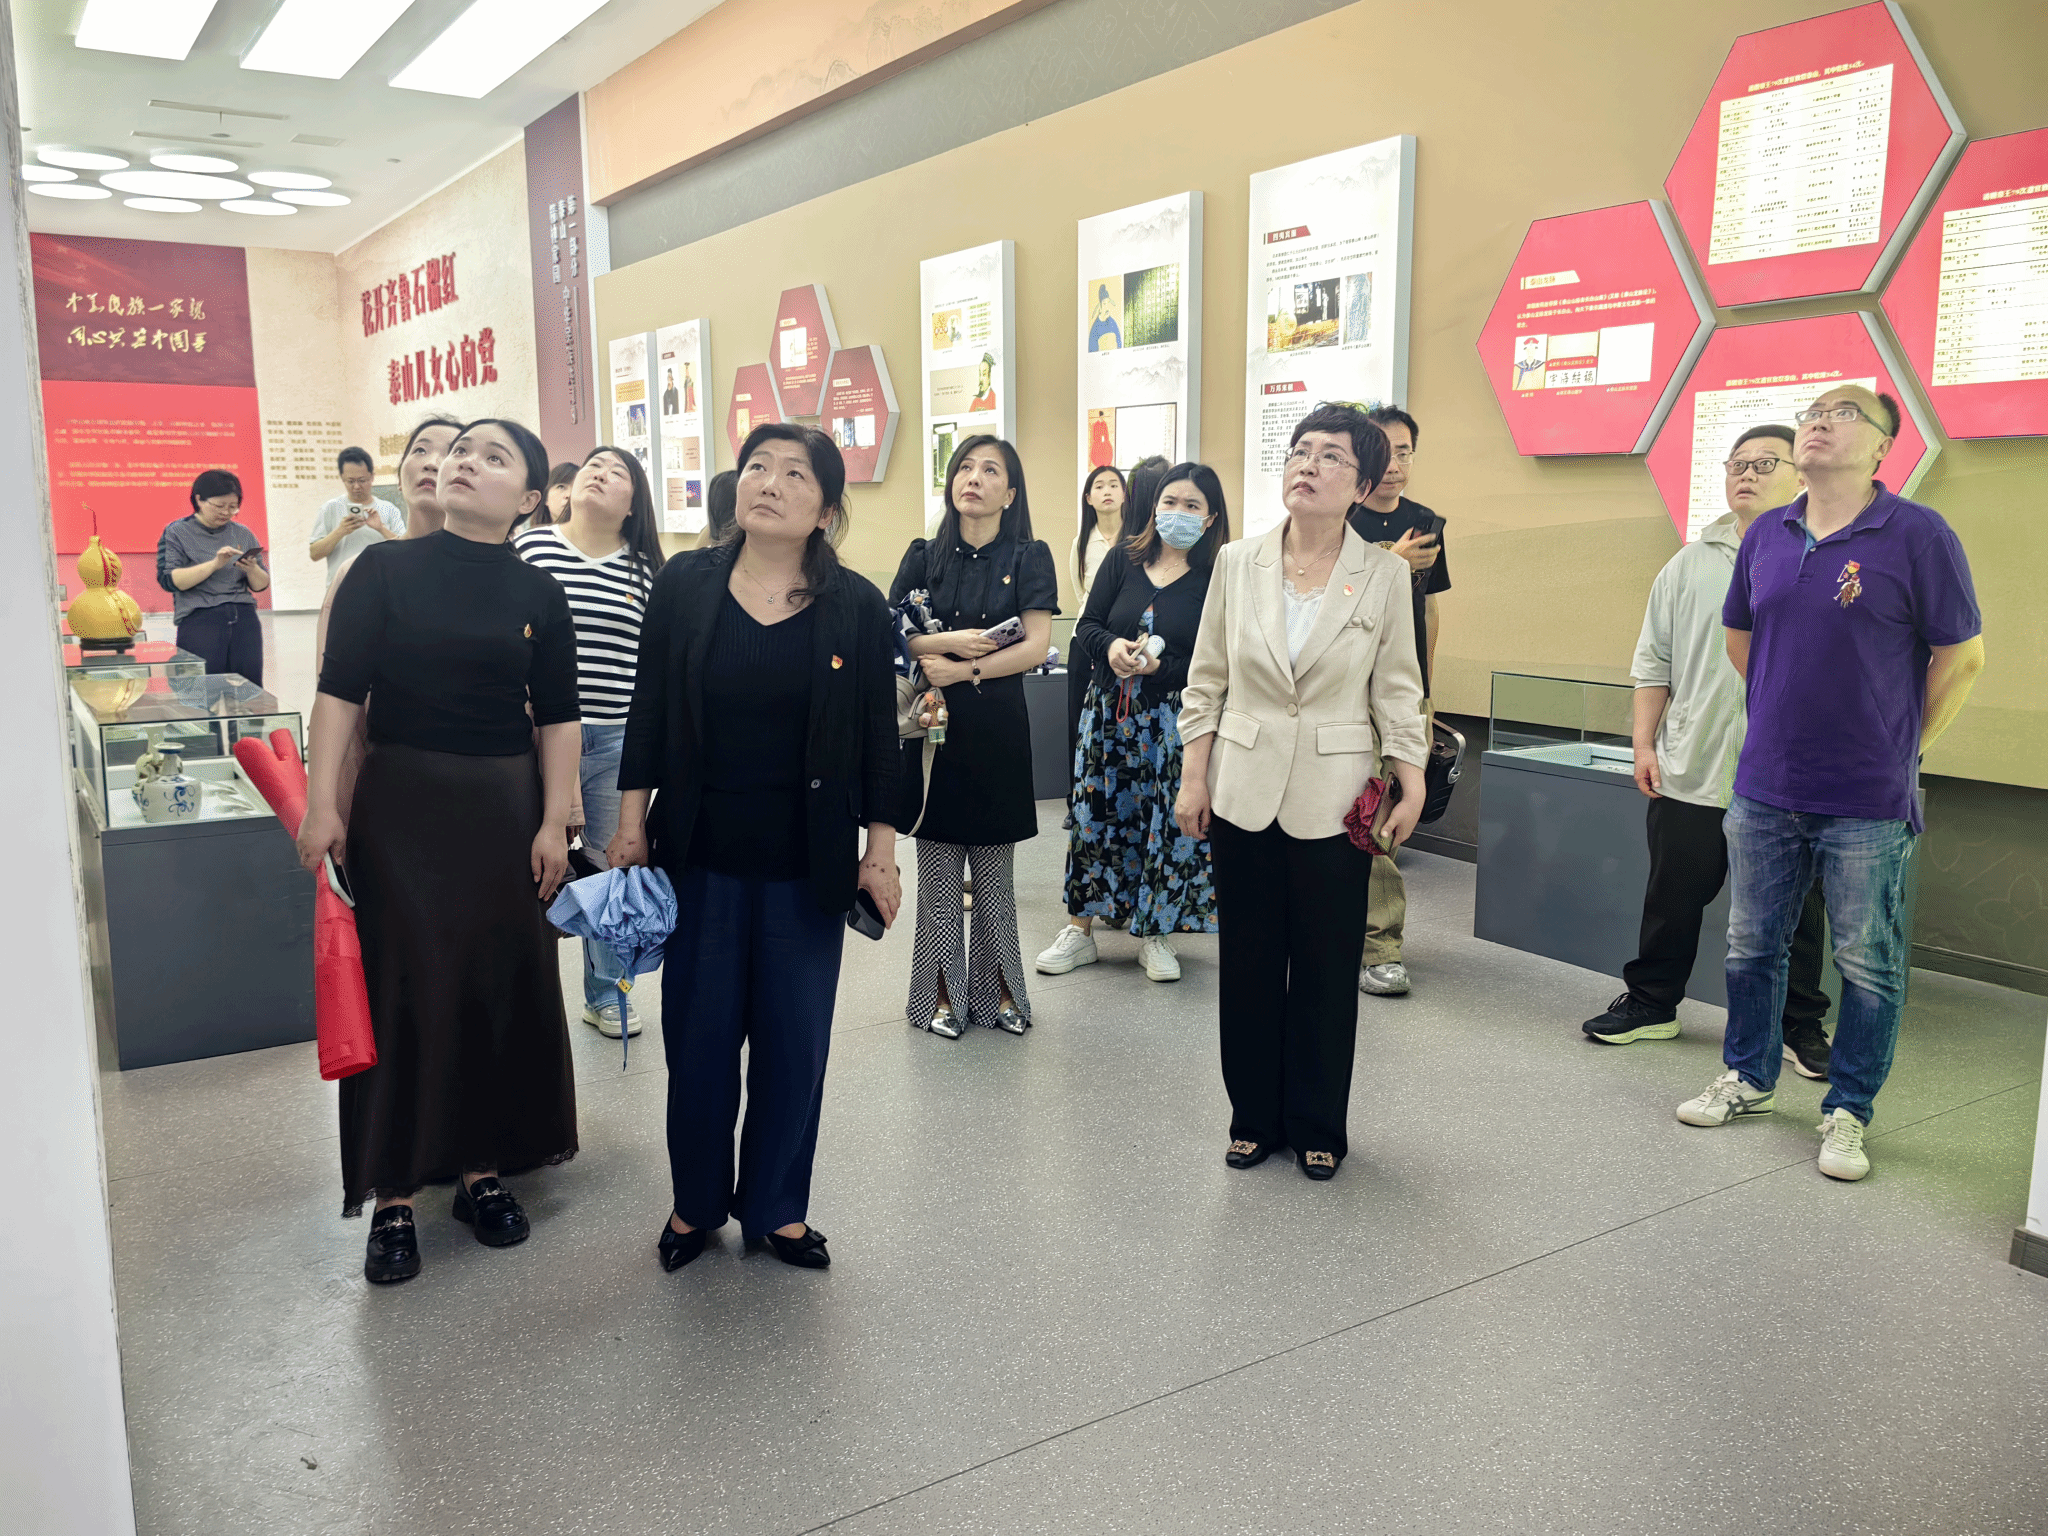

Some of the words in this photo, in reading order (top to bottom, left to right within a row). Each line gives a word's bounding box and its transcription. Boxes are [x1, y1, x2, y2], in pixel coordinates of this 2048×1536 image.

[65, 292, 206, 320] 中华民族一家亲
[361, 252, 459, 338] 花开齐鲁石榴红
[67, 325, 207, 353] 同心共筑中国梦
[388, 327, 498, 405] 泰山儿女心向党
